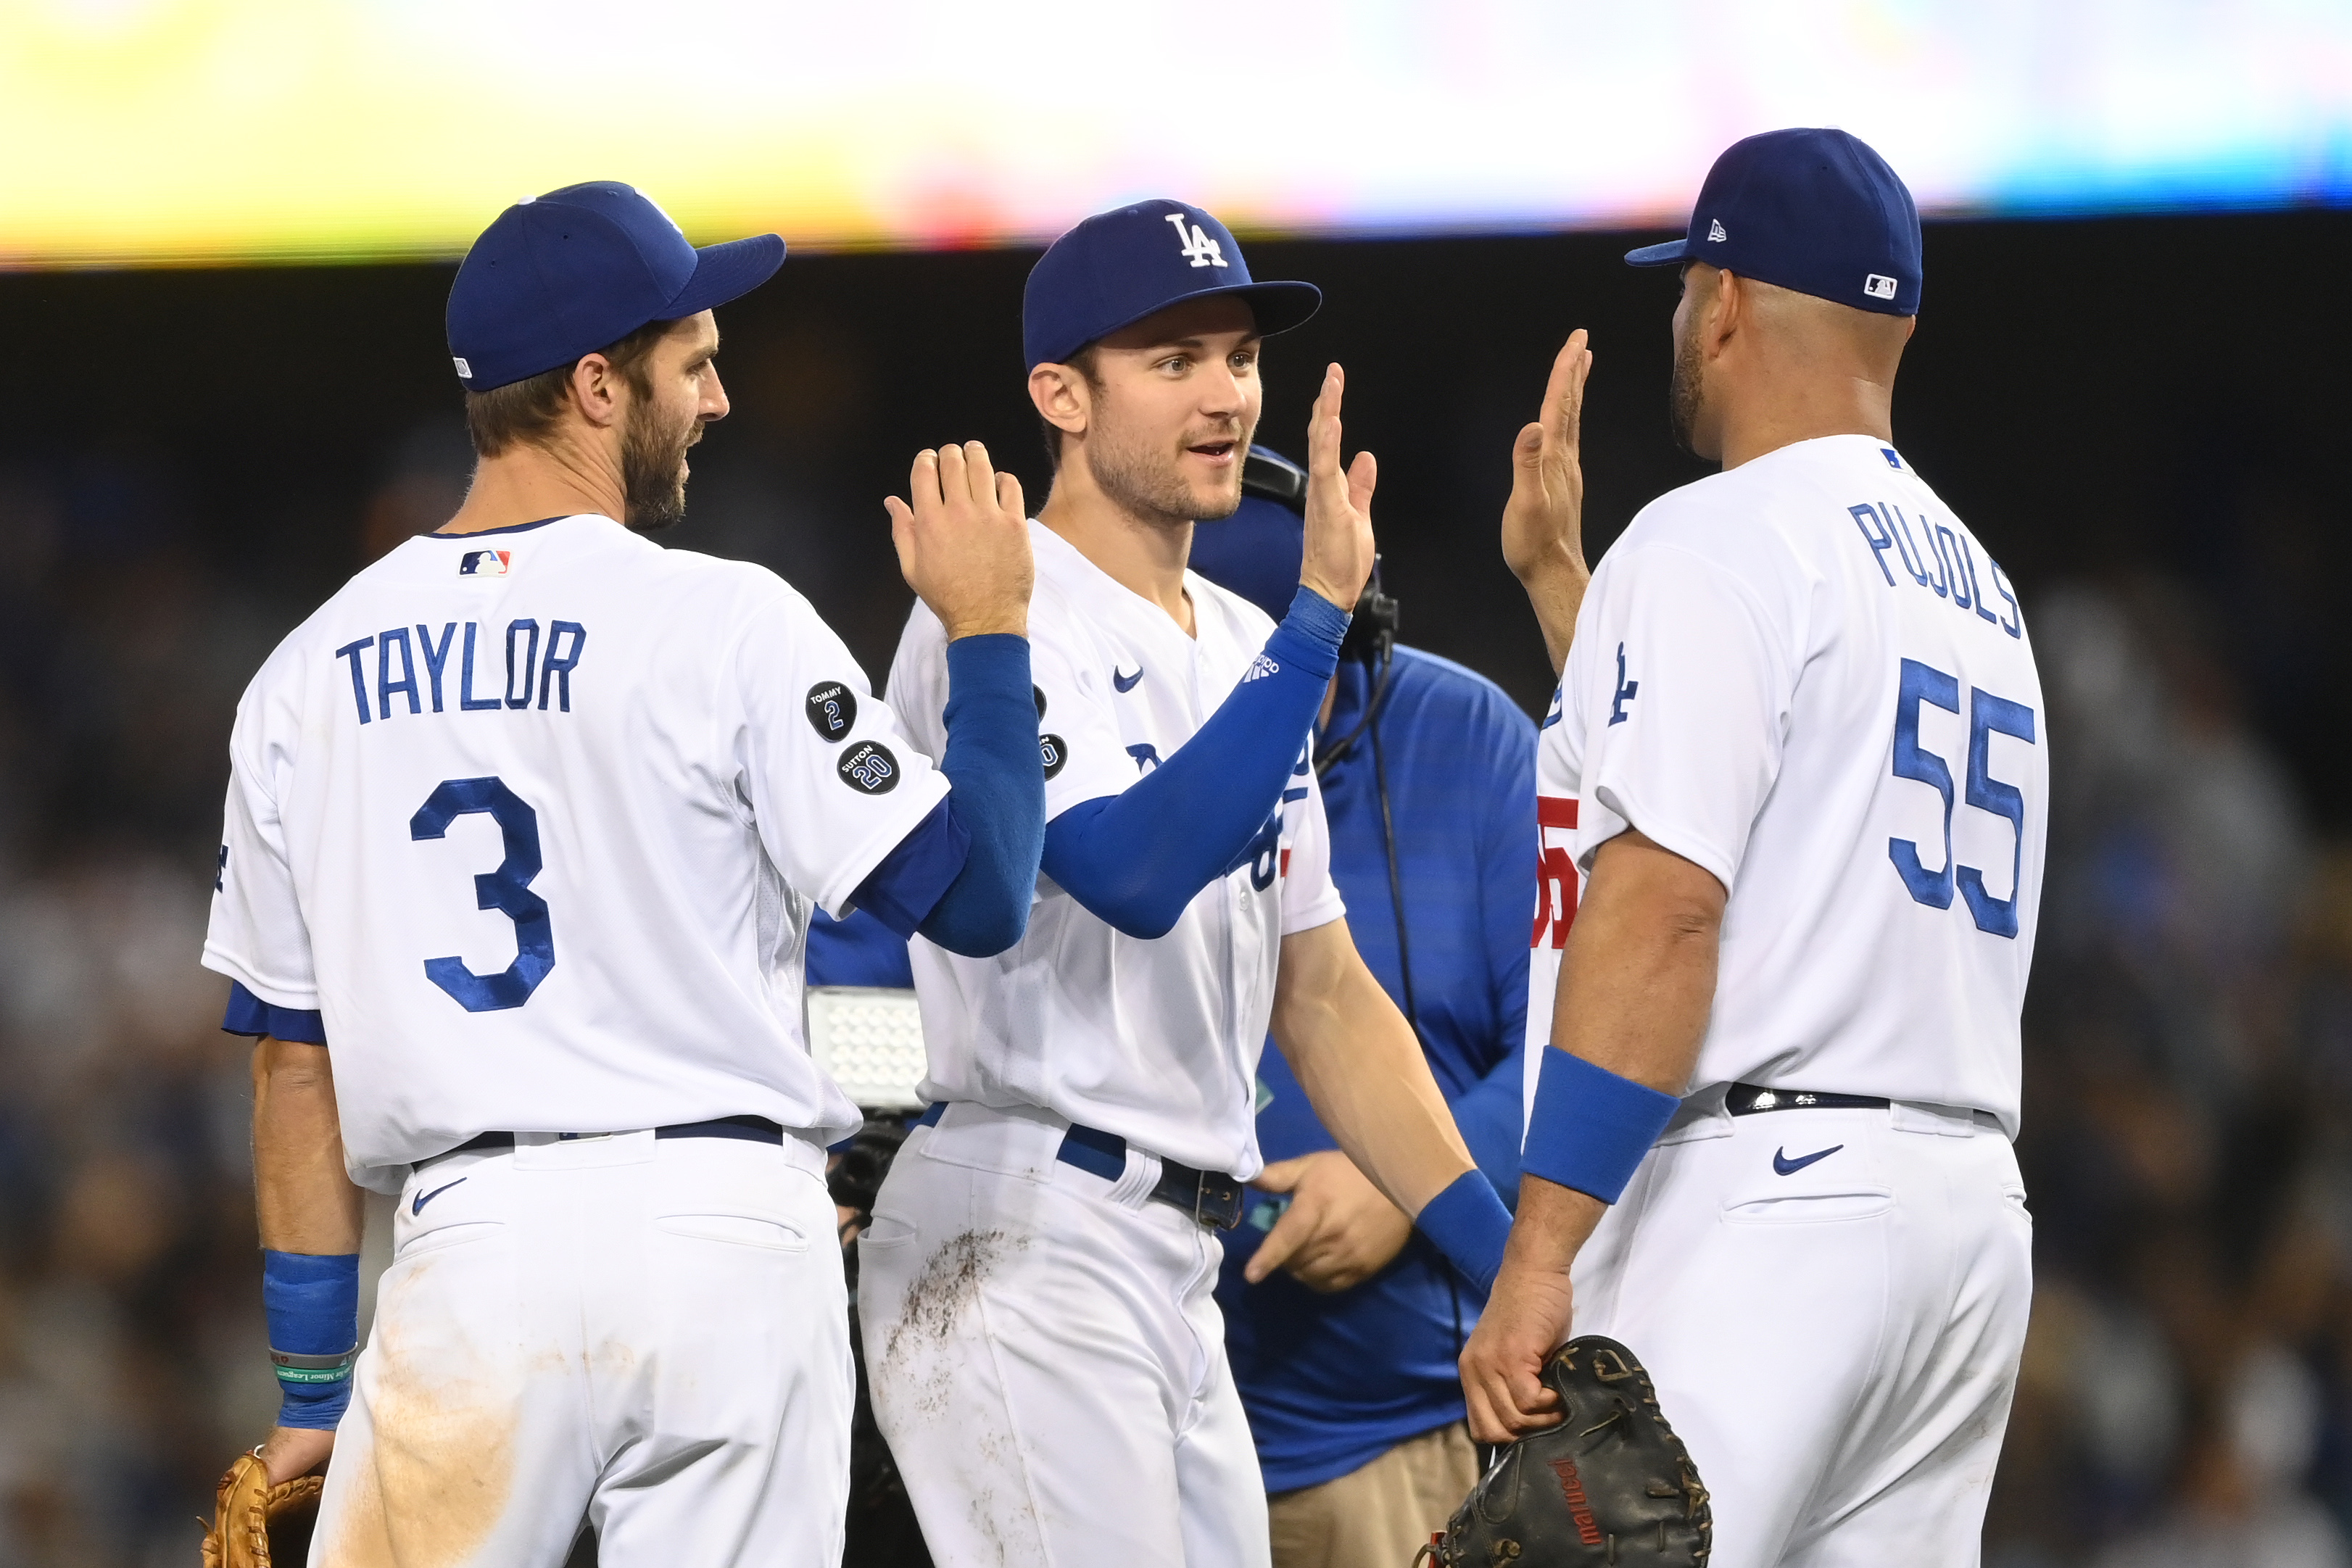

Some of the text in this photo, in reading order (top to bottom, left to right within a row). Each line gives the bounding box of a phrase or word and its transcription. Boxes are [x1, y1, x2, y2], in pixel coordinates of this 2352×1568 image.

[1164, 213, 1228, 267] LA
[1847, 502, 2021, 639] PUJOLS
[335, 618, 586, 725] TAYLOR
[811, 686, 842, 705] TOMMY
[824, 700, 844, 731] 2
[842, 744, 874, 773] SUTTON
[853, 754, 893, 789] 20
[1889, 657, 2034, 939] 55
[410, 776, 555, 1013] 3
